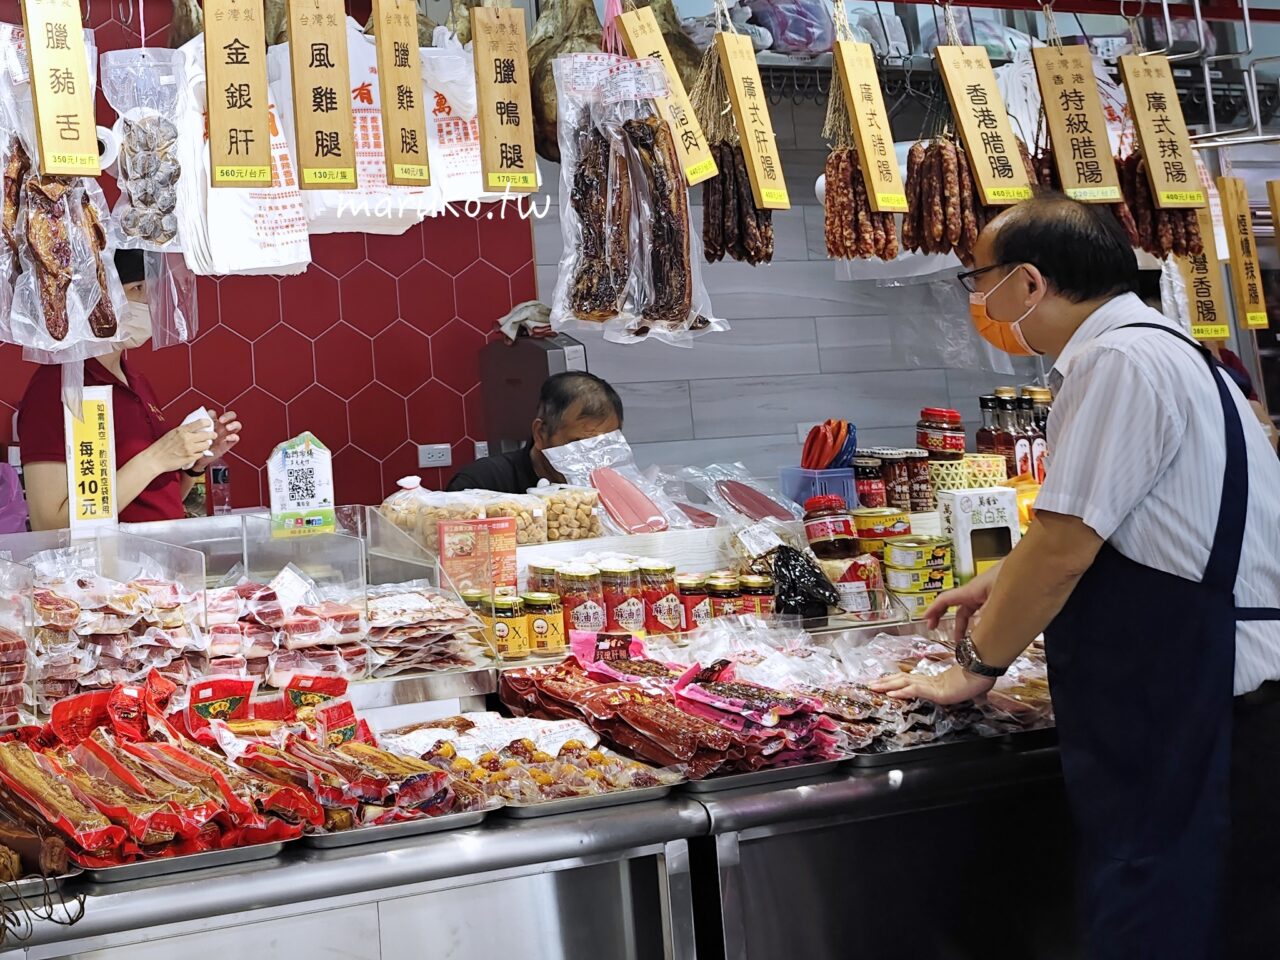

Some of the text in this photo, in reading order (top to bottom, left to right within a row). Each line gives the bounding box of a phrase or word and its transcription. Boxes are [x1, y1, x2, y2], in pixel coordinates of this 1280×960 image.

[214, 8, 255, 22] 台灣製
[299, 13, 338, 27] 台灣製
[384, 12, 412, 27] 台灣製
[483, 23, 520, 36] 台灣製
[45, 22, 80, 141] 臘豬舌
[1045, 58, 1085, 71] 台灣製
[1051, 72, 1085, 85] 香港
[1132, 67, 1166, 79] 台灣製
[223, 38, 255, 156] 金銀肝
[309, 43, 342, 158] 風雞腿
[394, 41, 419, 155] 臘雞腿
[493, 58, 524, 169] 臘鴨腿
[648, 50, 701, 155] 腊肉
[965, 83, 1014, 179] 香港腊腸
[1059, 89, 1103, 185] 特級腊腸
[1145, 91, 1187, 184] 廣式辣腸
[220, 169, 267, 178] 560元/台斤
[313, 171, 348, 180] 130元/隻
